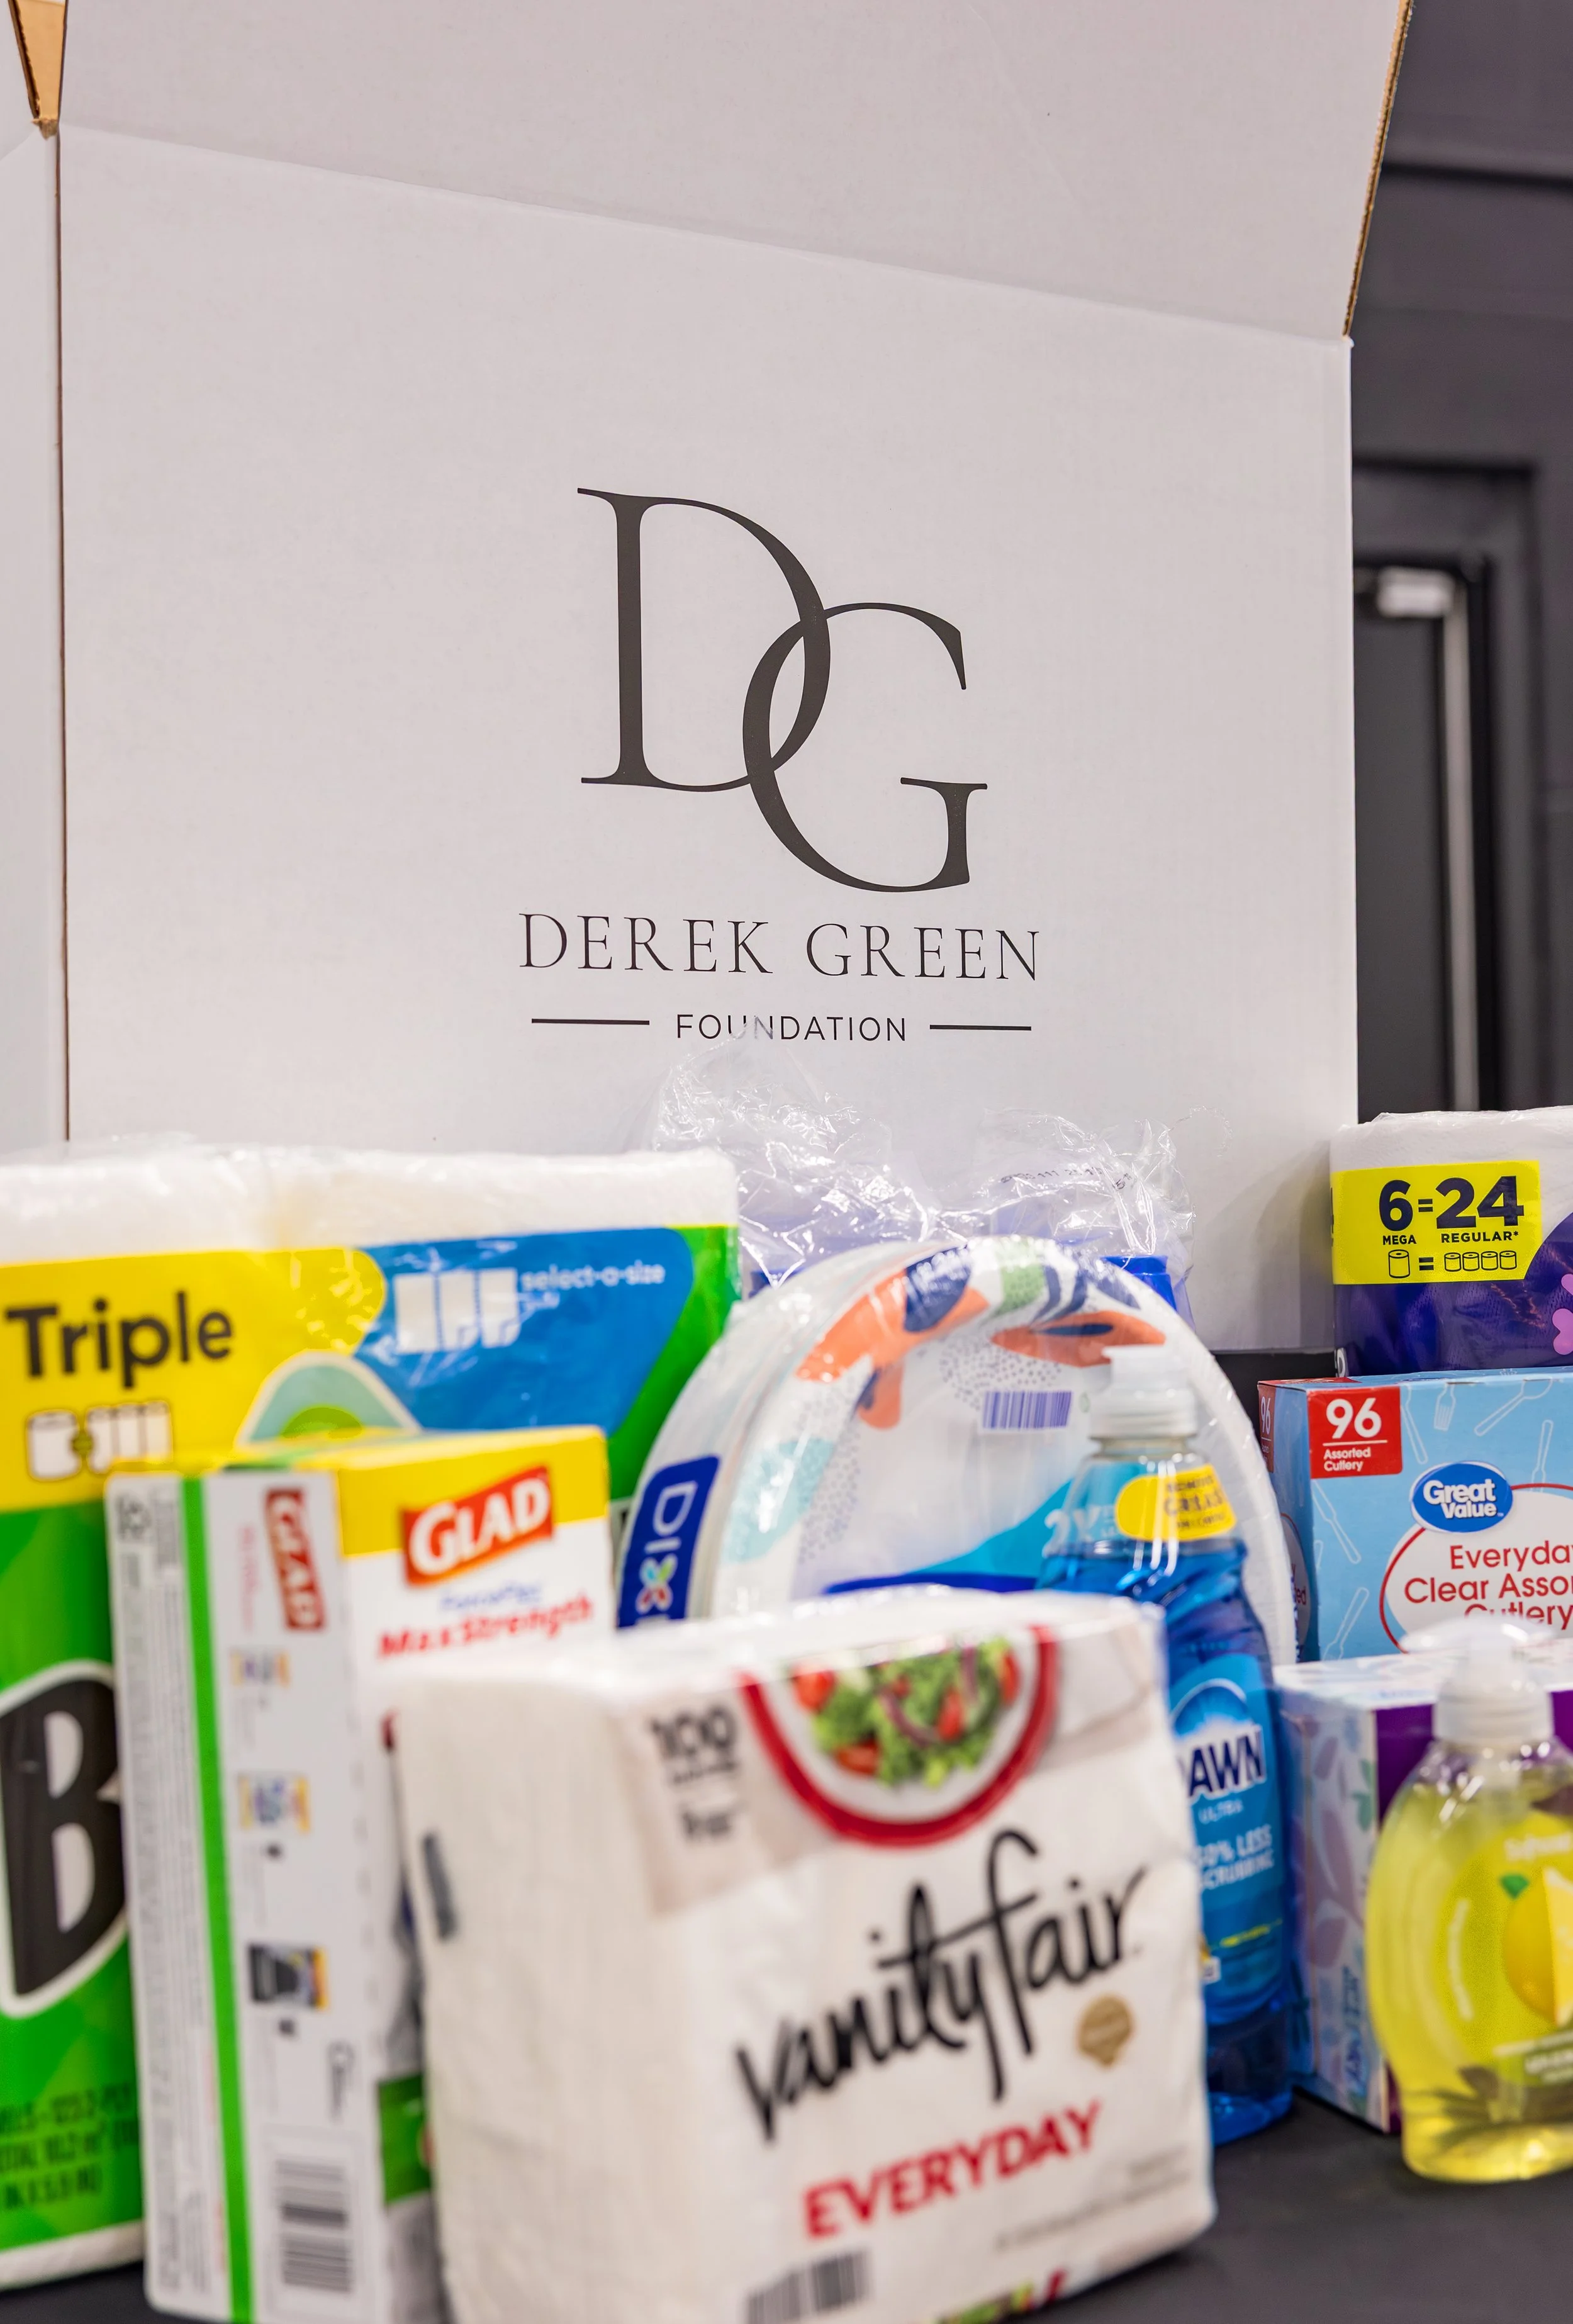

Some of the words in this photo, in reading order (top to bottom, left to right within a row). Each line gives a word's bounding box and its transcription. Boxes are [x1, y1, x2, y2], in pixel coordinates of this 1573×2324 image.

[519, 913, 773, 974] DEREK
[805, 923, 1039, 981] GREEN
[1382, 1234, 1417, 1245] MEGA
[5, 1290, 233, 1389] Triple
[1260, 1396, 1271, 1435] 96
[1326, 1397, 1382, 1439] 96
[1323, 1447, 1372, 1459] Assorted
[1323, 1460, 1363, 1472] Cutlery
[1423, 1479, 1496, 1505] Great
[1441, 1500, 1497, 1519] Value
[409, 1476, 552, 1576] GLAD
[1450, 1541, 1573, 1572] Everyda
[1404, 1577, 1489, 1603] Clear
[1180, 1731, 1263, 1797] AWN
[736, 1882, 1007, 2142] vanity
[988, 1829, 1146, 2055] fair
[802, 2098, 1102, 2240] EVERYDAY
